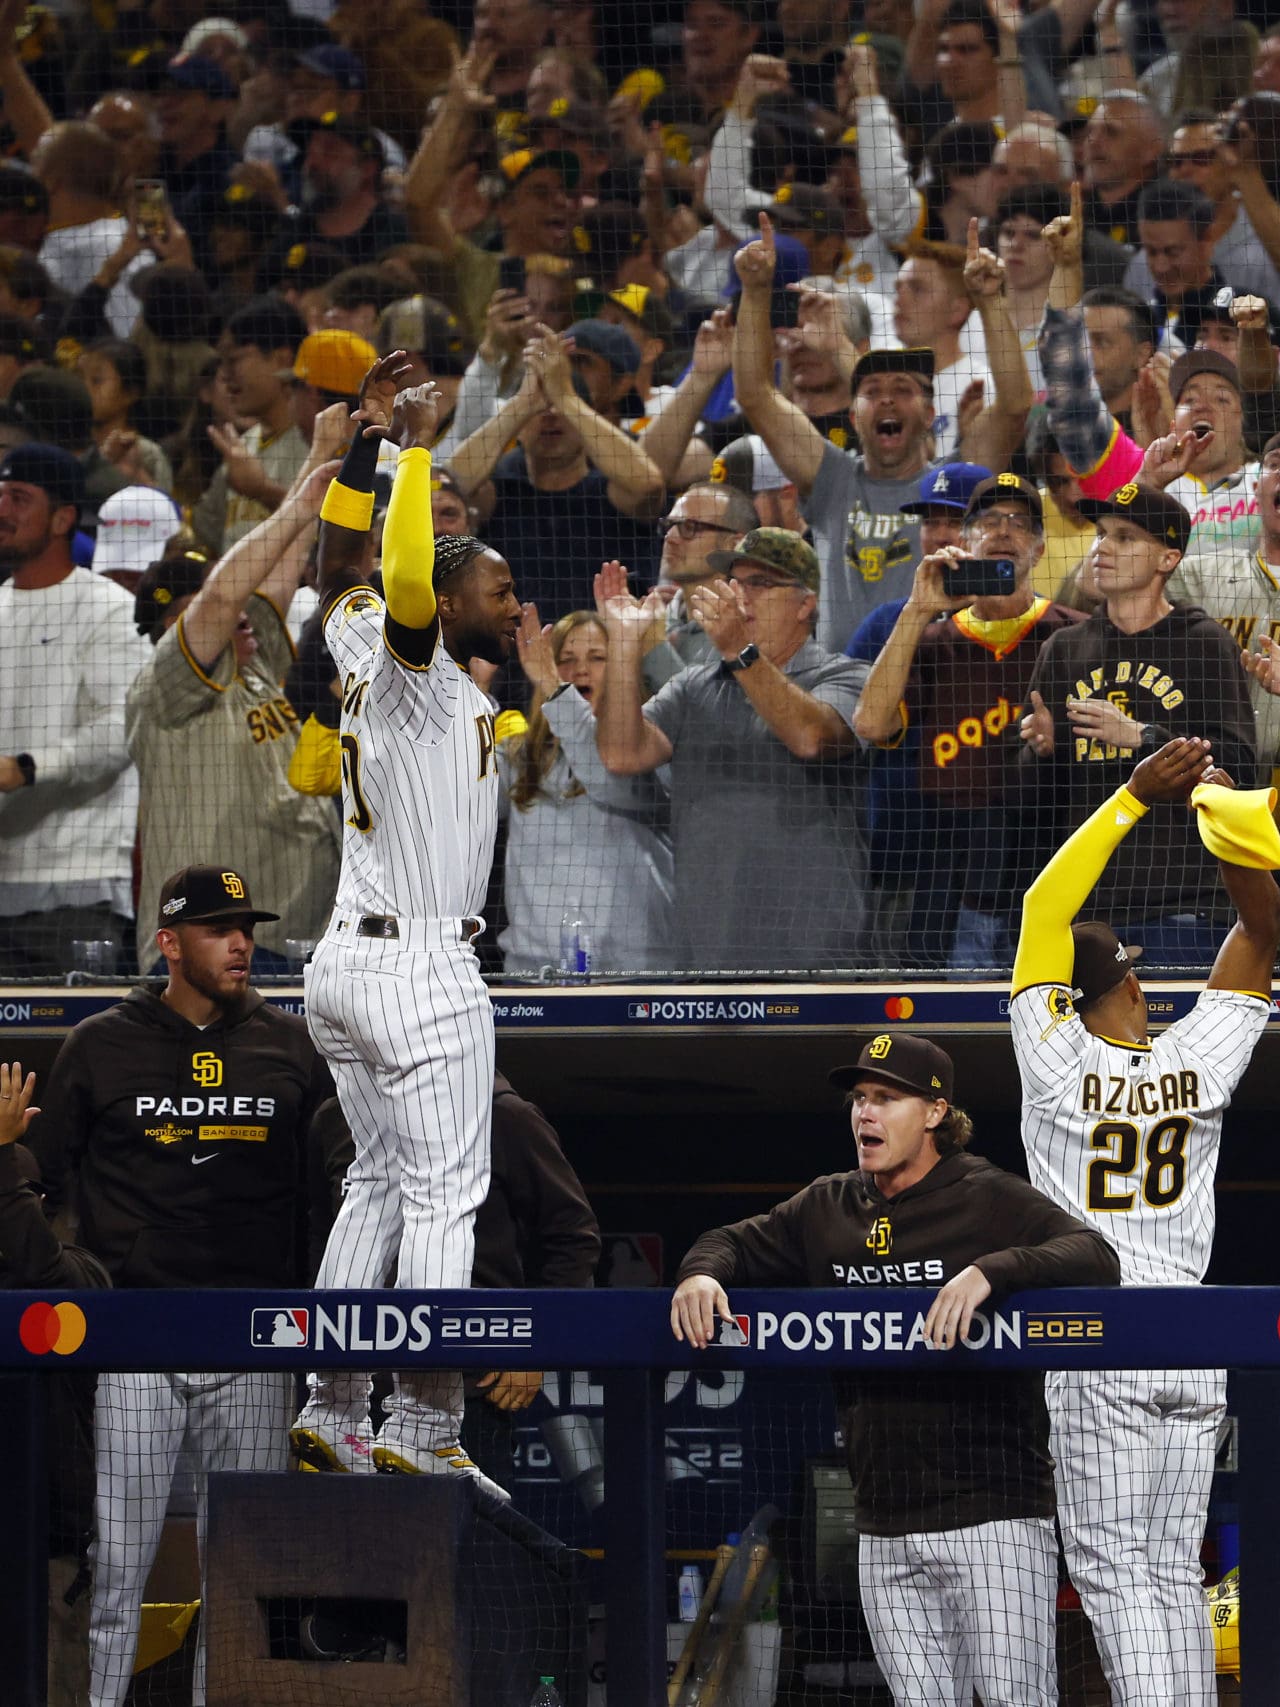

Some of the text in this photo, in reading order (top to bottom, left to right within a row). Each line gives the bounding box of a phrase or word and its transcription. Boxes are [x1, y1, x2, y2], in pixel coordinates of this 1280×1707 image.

[220, 871, 246, 899] SD
[493, 1003, 544, 1017] he show.
[651, 1001, 800, 1020] POSTSEASON 2022
[1147, 1003, 1174, 1012] 022
[869, 1033, 893, 1060] SD
[191, 1051, 224, 1088] SD
[135, 1096, 276, 1118] PADRES
[202, 1129, 226, 1137] SAN
[230, 1129, 267, 1138] DIEGO
[1087, 1116, 1193, 1213] 28
[831, 1258, 945, 1286] PADRES
[314, 1303, 533, 1352] NLDS 2022
[756, 1310, 1104, 1351] POSTSEAON 2022
